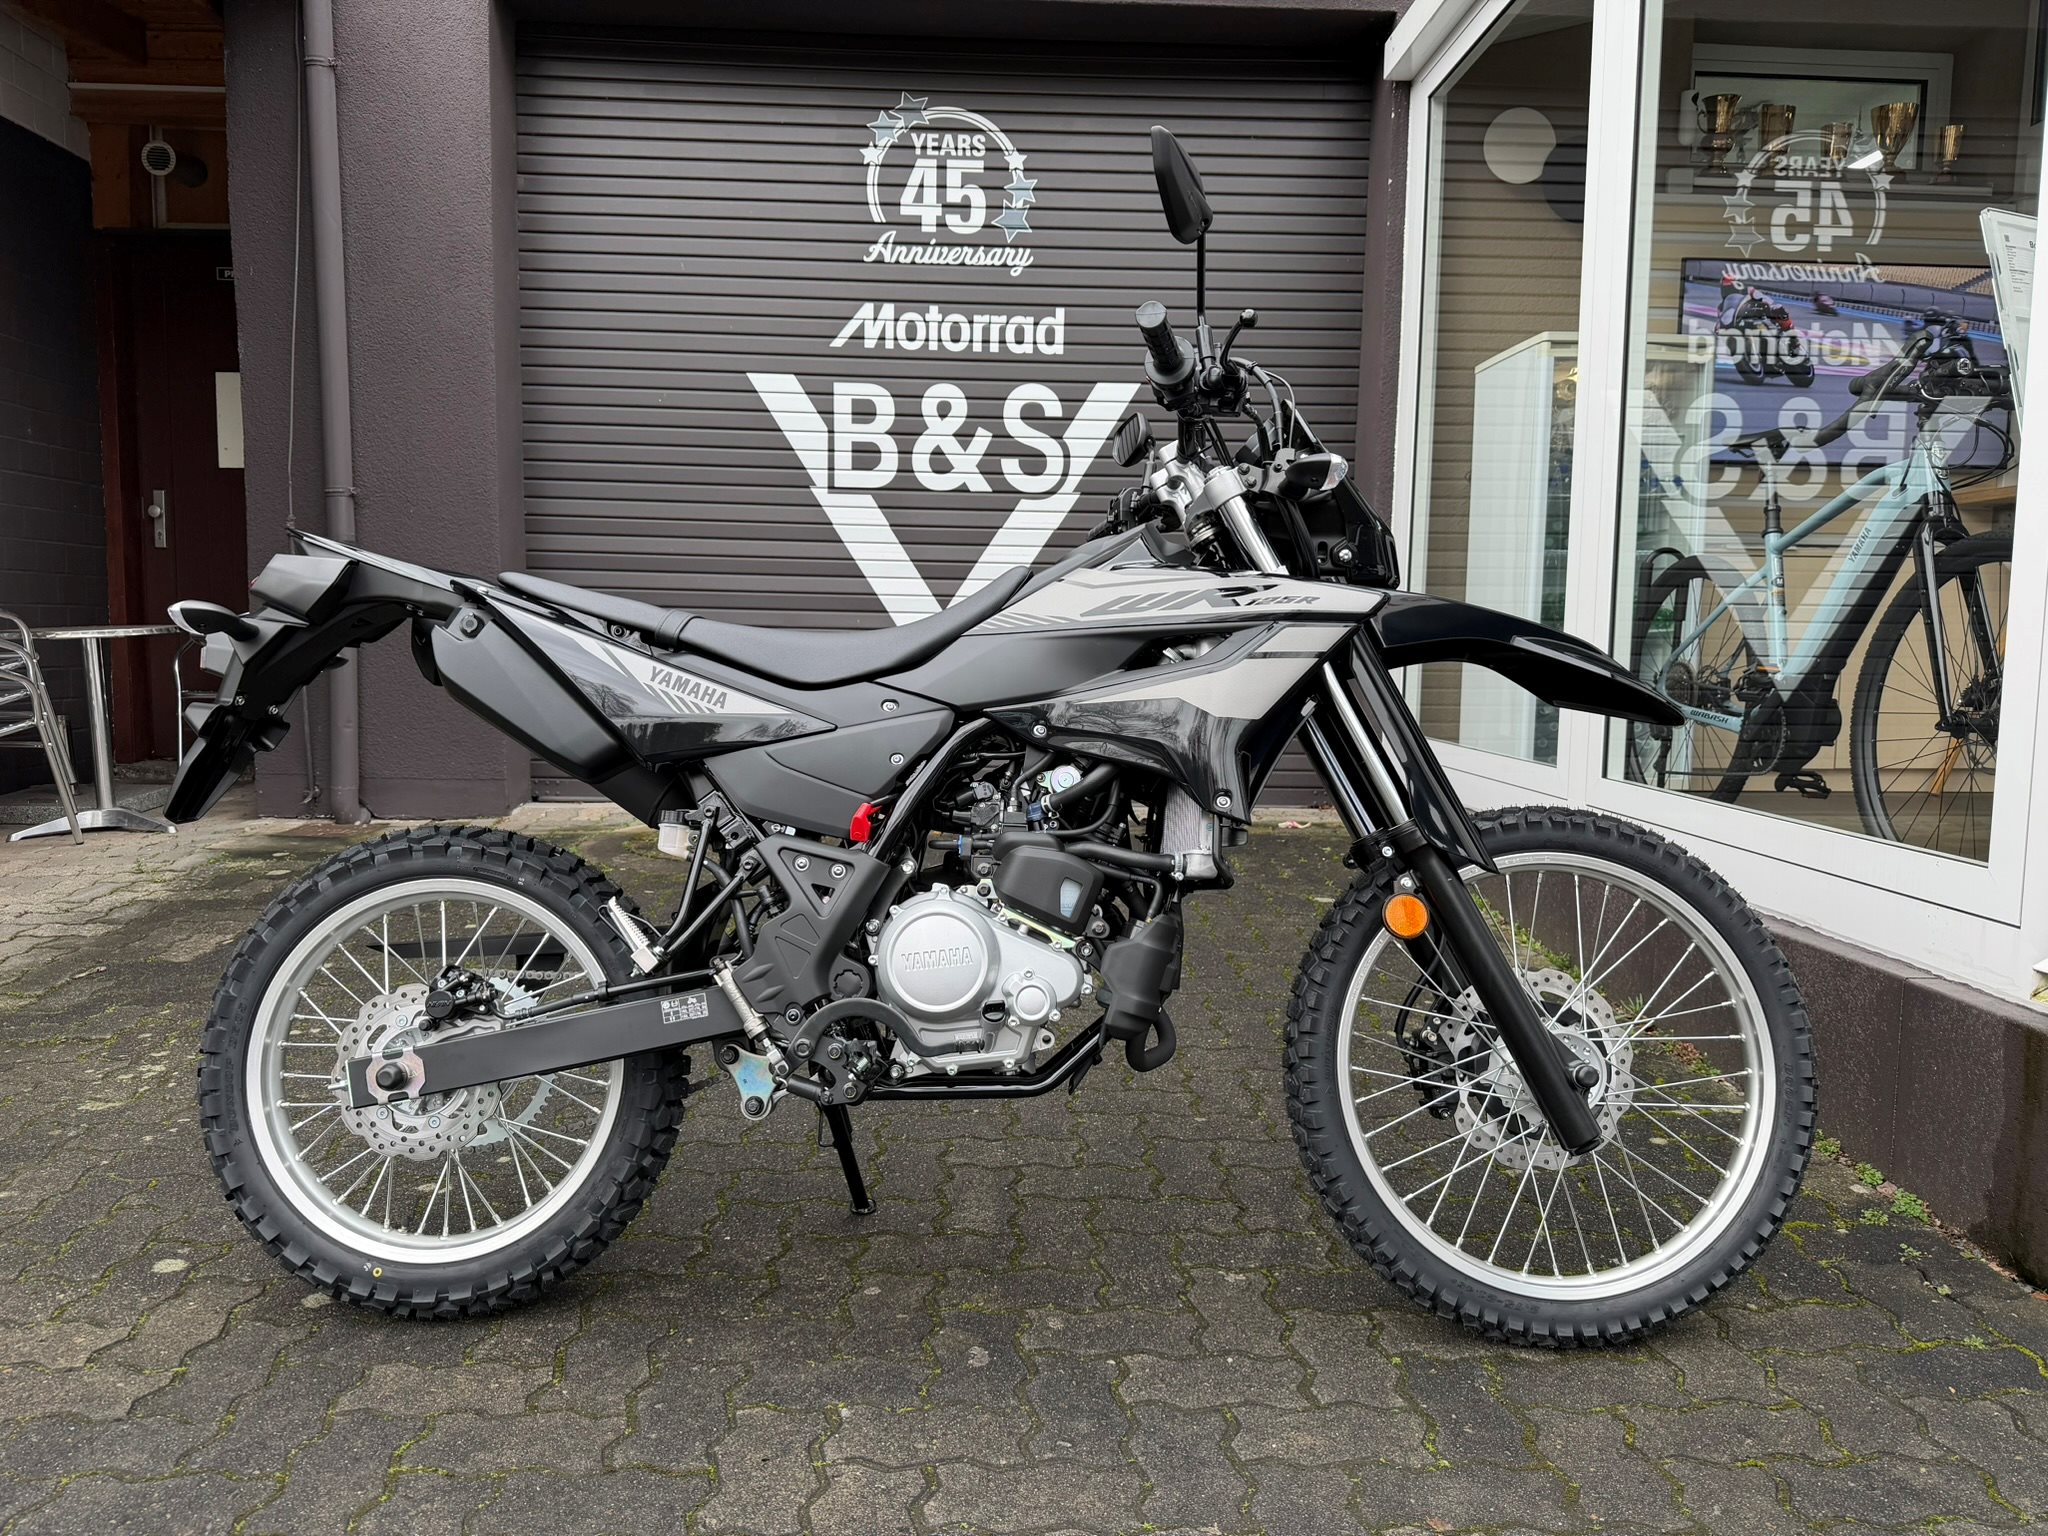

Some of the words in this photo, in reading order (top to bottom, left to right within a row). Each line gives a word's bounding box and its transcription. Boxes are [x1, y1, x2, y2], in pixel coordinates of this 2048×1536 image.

[911, 133, 986, 157] YEARS
[900, 158, 987, 235] 45
[863, 230, 1034, 277] Anniversary
[829, 302, 1065, 355] Motorrad
[1848, 527, 1871, 562] YAMAHA
[650, 665, 728, 710] YAMAHA
[1690, 709, 1729, 724] WABASH
[901, 946, 973, 972] YAMAHA
